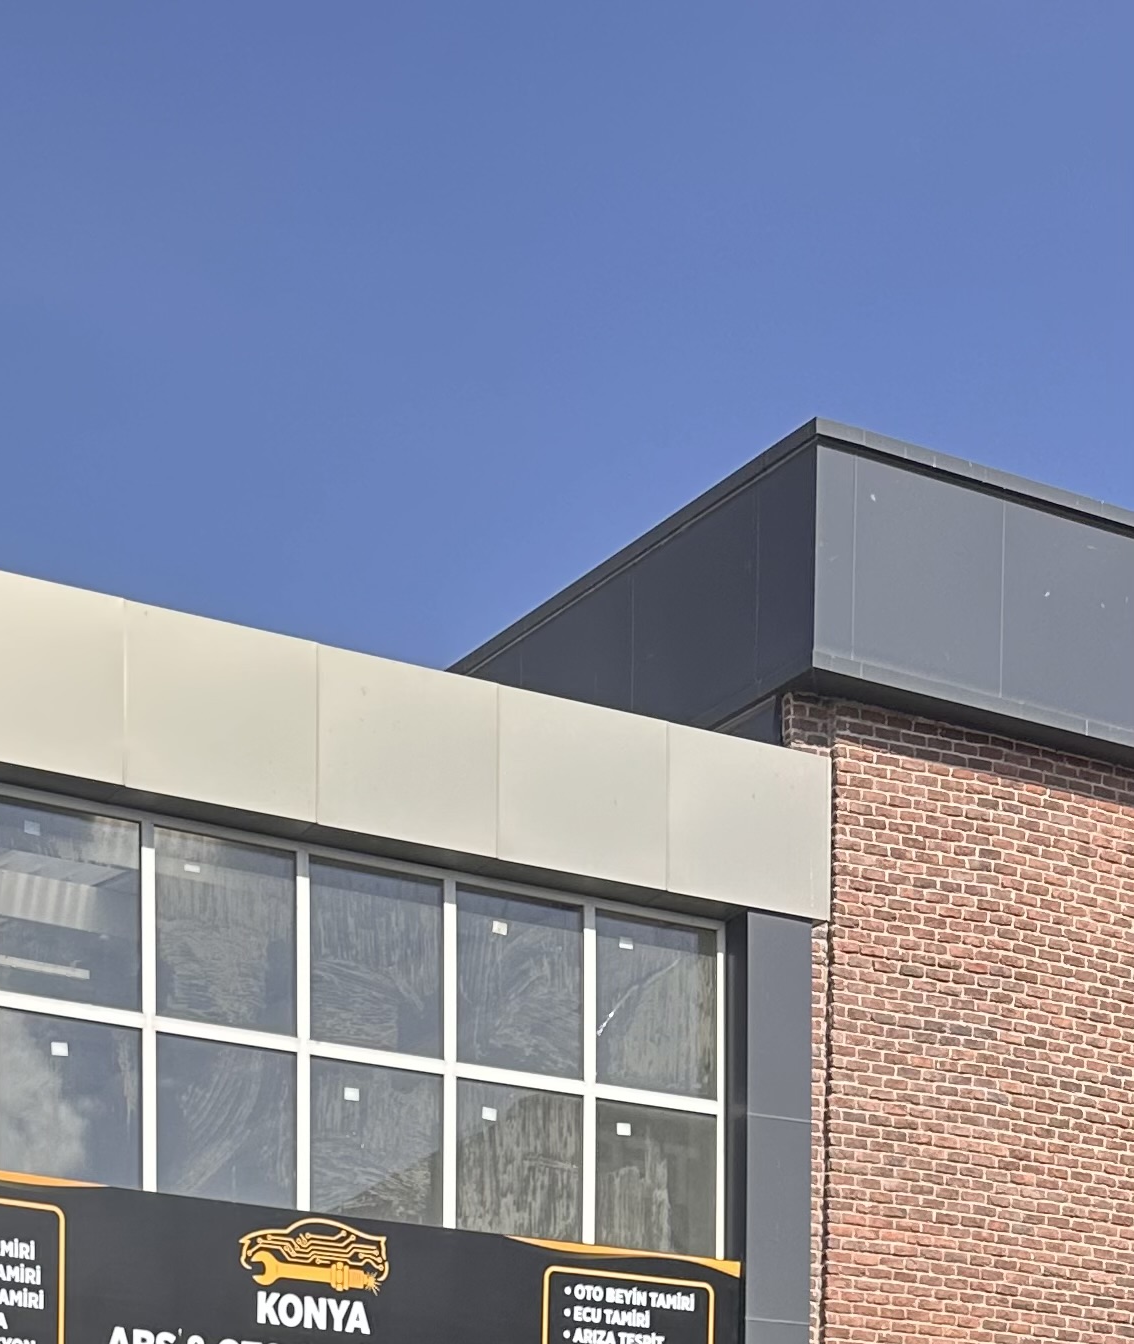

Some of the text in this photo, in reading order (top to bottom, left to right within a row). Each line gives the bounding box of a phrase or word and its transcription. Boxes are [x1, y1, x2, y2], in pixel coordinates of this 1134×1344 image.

[574, 1283, 695, 1312] OTO BEYİN TAMİRİ
[256, 1290, 371, 1335] KONYA
[573, 1305, 650, 1328] ECU TAMİRİ
